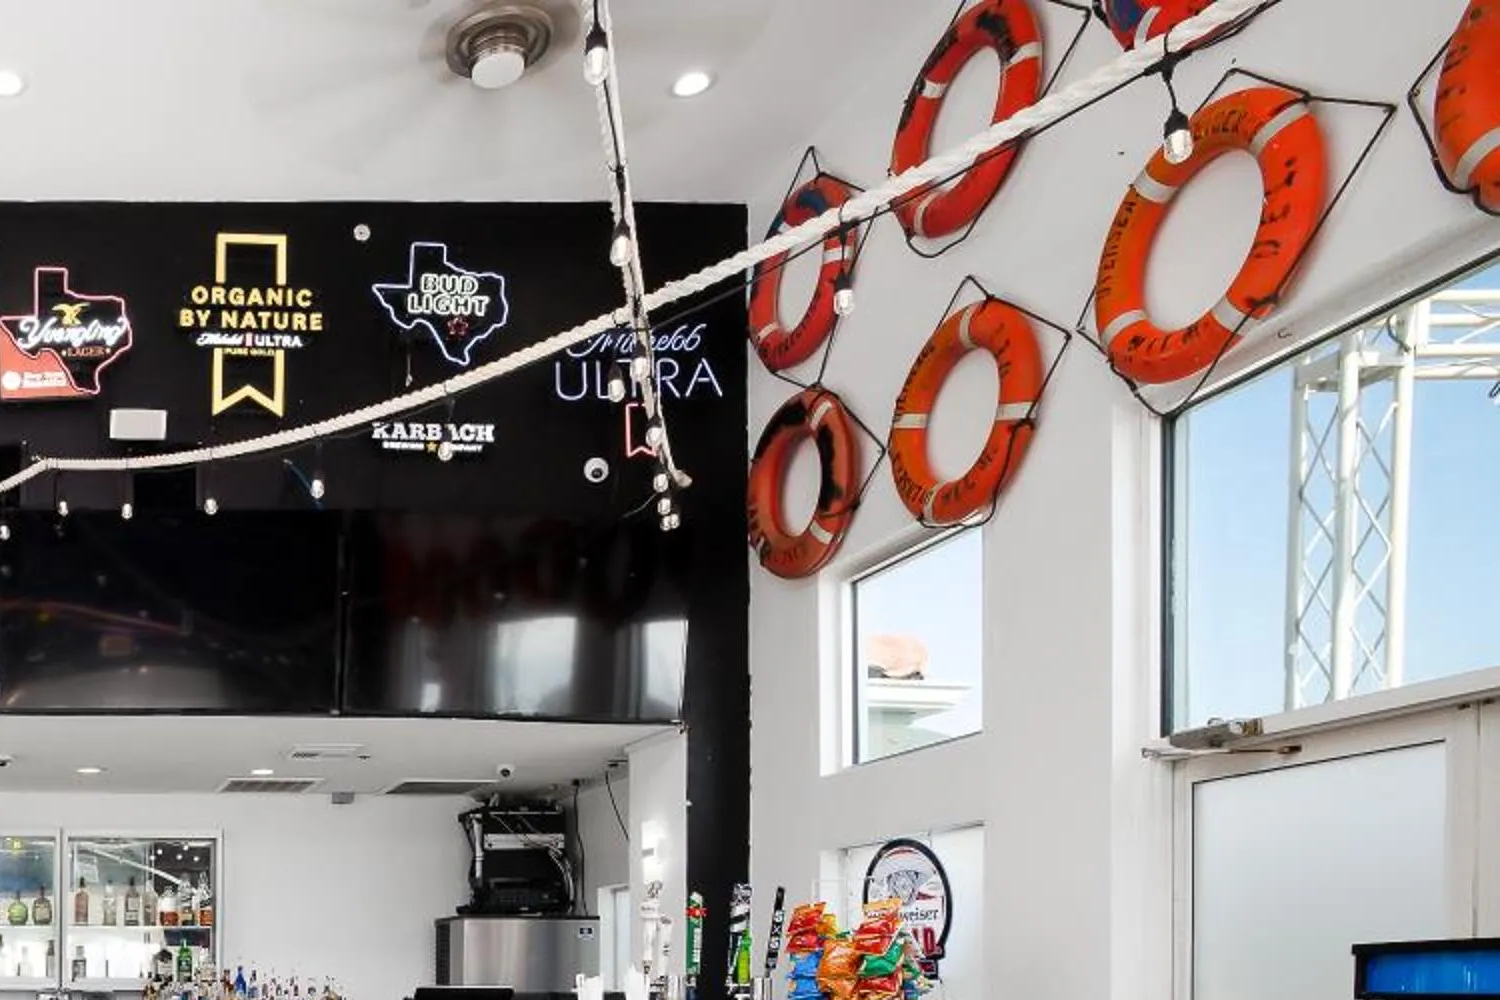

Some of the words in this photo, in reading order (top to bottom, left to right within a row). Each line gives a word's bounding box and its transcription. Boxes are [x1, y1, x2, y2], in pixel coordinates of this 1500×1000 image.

[420, 272, 479, 296] BUD
[191, 285, 314, 309] ORGANIC
[407, 292, 490, 317] LIGHT
[179, 308, 211, 328] BY
[220, 309, 324, 331] NATURE
[15, 315, 130, 350] Yuengling
[254, 333, 304, 348] ULTRA
